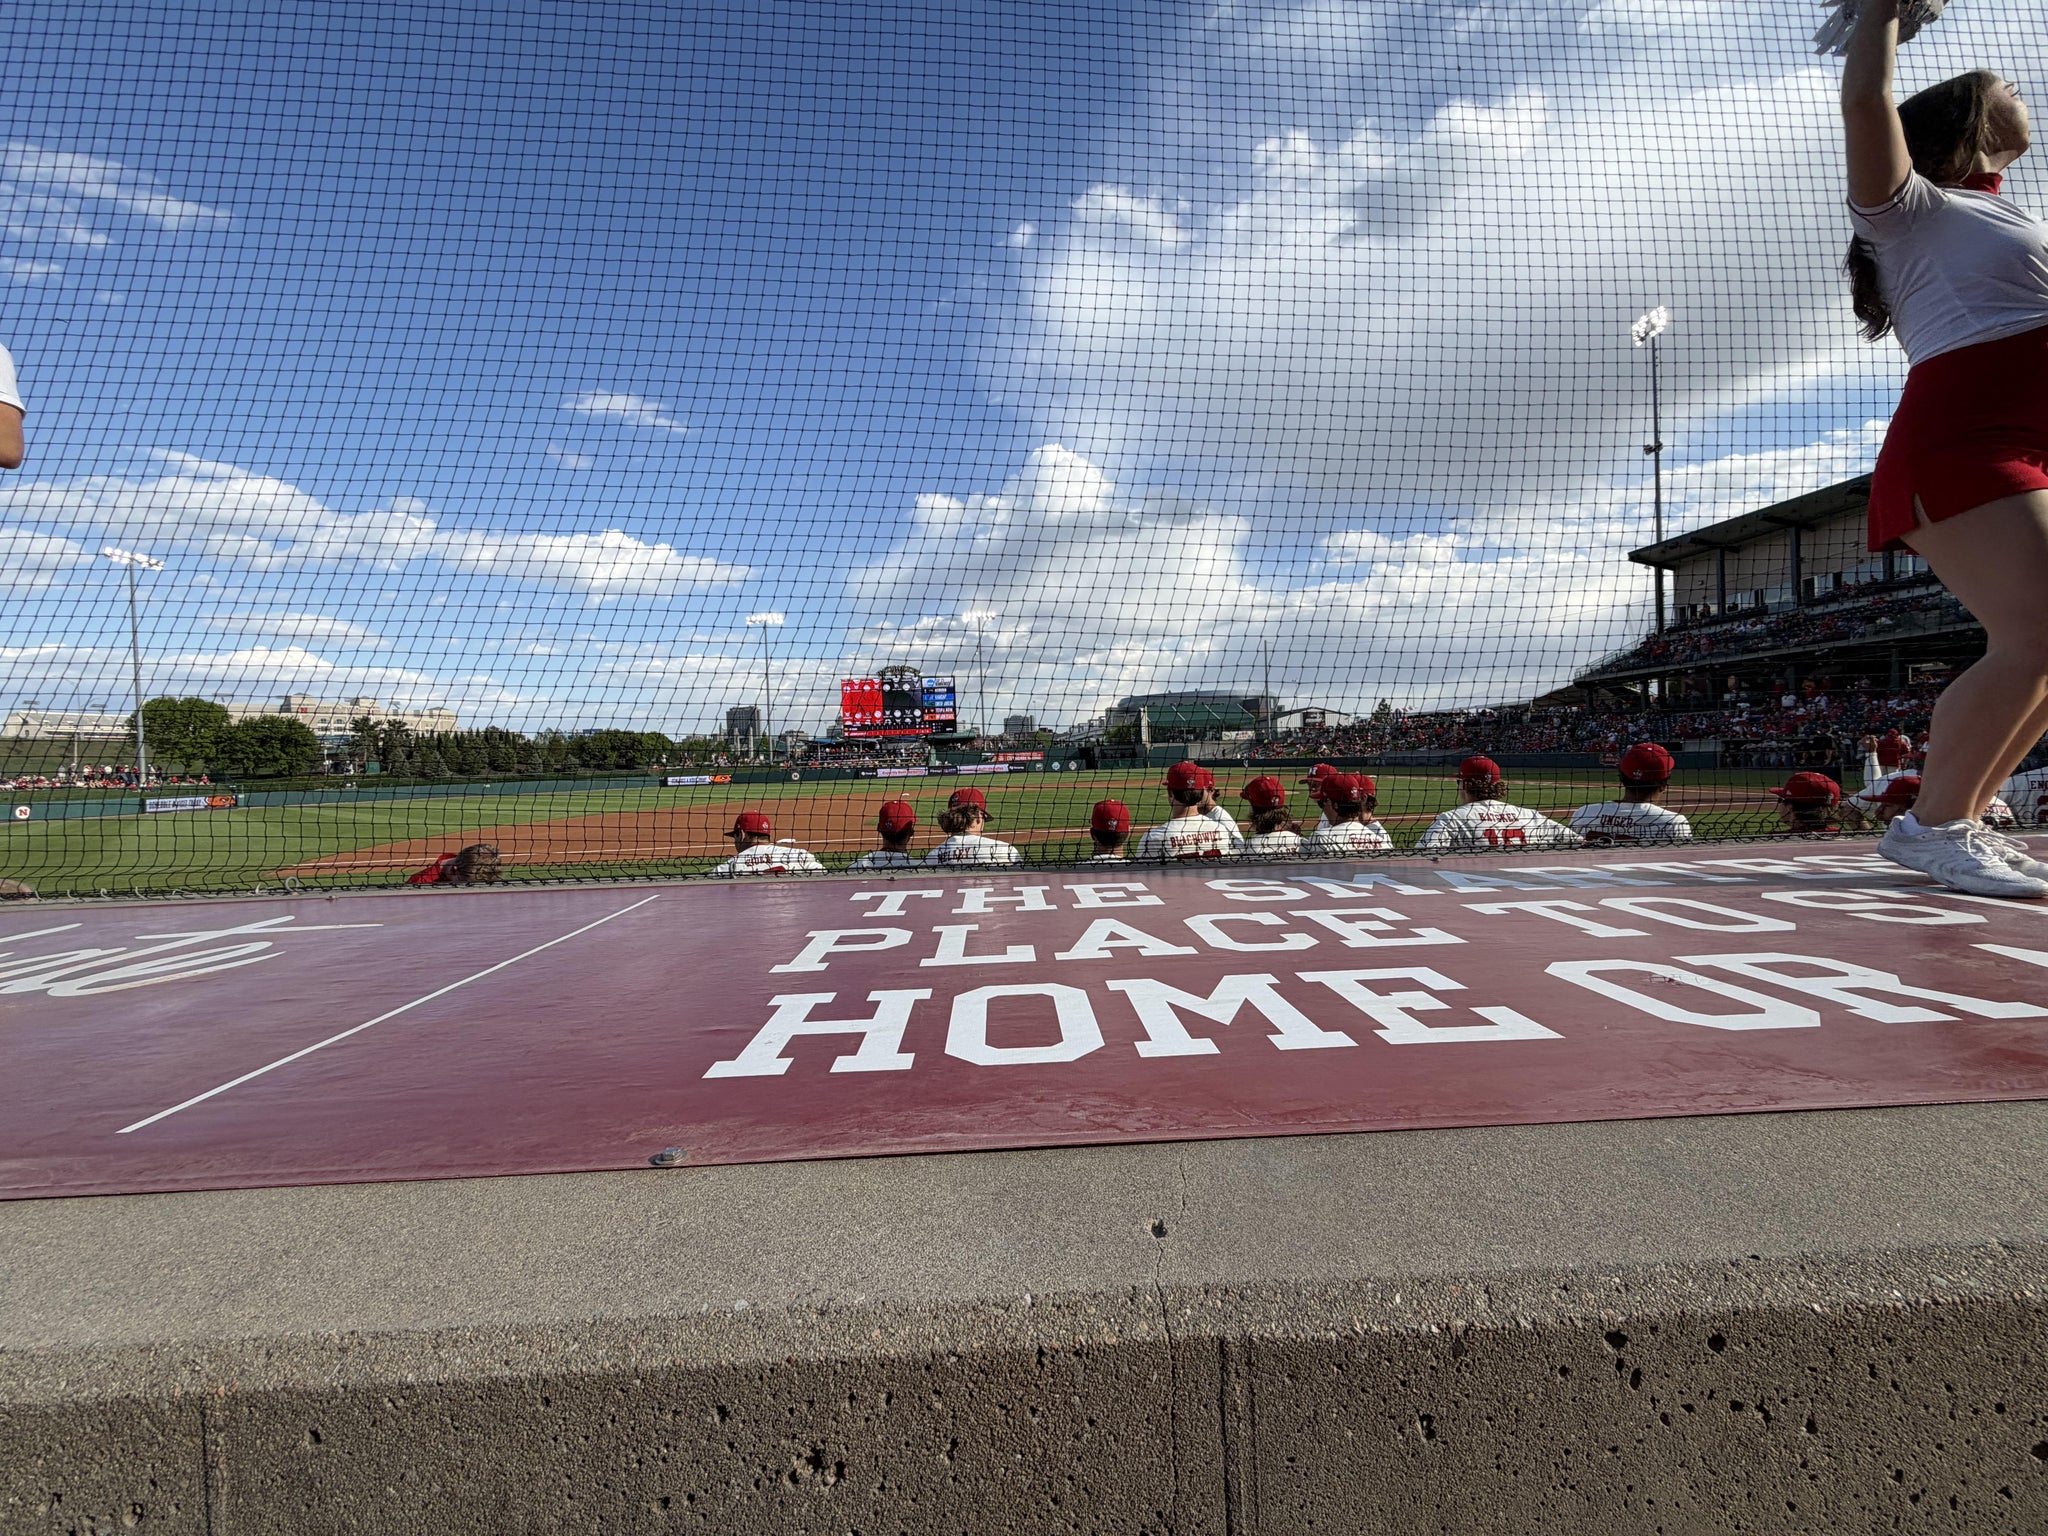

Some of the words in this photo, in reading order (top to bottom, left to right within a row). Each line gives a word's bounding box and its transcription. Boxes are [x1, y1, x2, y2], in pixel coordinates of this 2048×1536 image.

[1600, 814, 1633, 828] UNGER
[849, 882, 1165, 917] THE
[1205, 854, 1931, 901] SMARTES
[768, 907, 1469, 973] PLACE
[1460, 896, 1796, 937] TO
[702, 966, 1566, 1079] HOME
[1544, 952, 2048, 1030] OR
